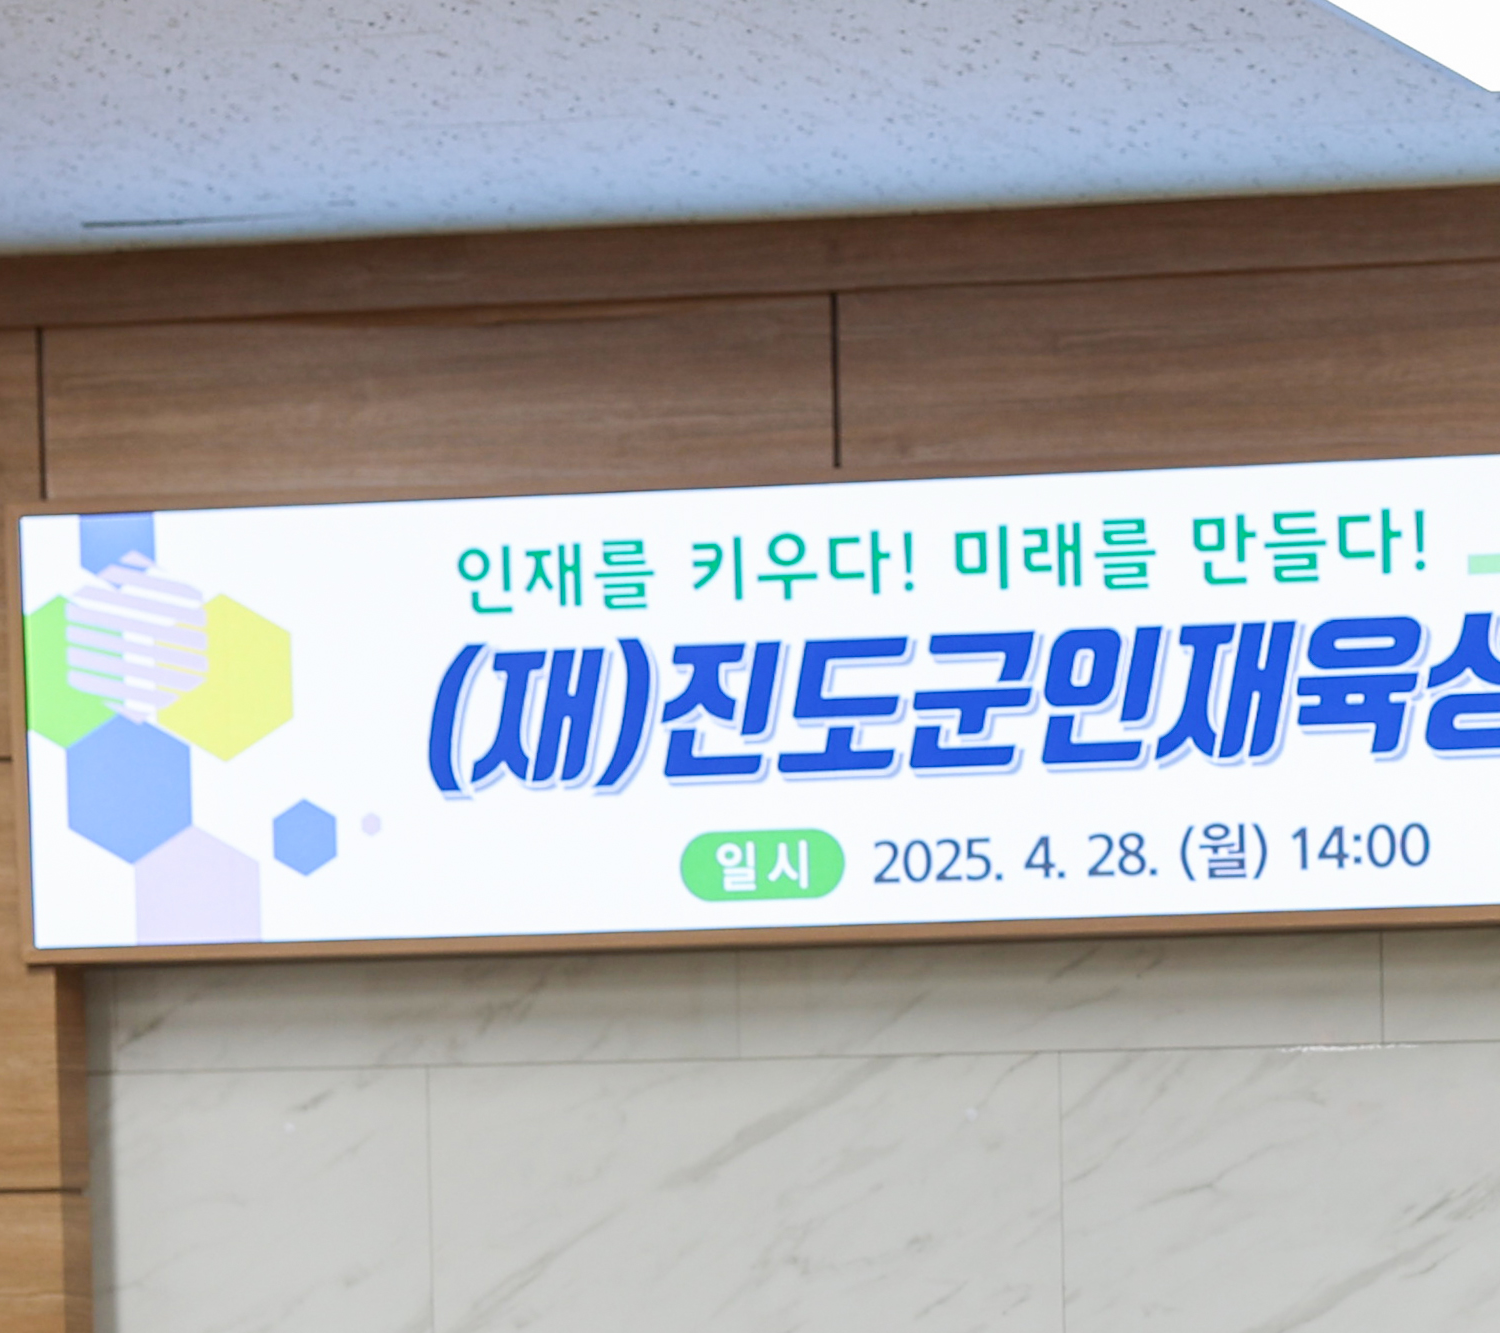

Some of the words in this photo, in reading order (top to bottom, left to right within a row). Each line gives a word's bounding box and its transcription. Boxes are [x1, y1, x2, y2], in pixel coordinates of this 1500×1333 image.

[457, 539, 655, 614] 인재를
[692, 530, 914, 601] 키우다!
[954, 518, 1156, 590] 미래를
[1193, 508, 1426, 586] 만들다!
[717, 842, 810, 890] 일시
[873, 837, 1003, 884] 2025.
[1024, 835, 1066, 879] 4.
[1087, 831, 1158, 877] 28.
[1180, 822, 1268, 882] (월)
[1291, 822, 1431, 871] 14:00
